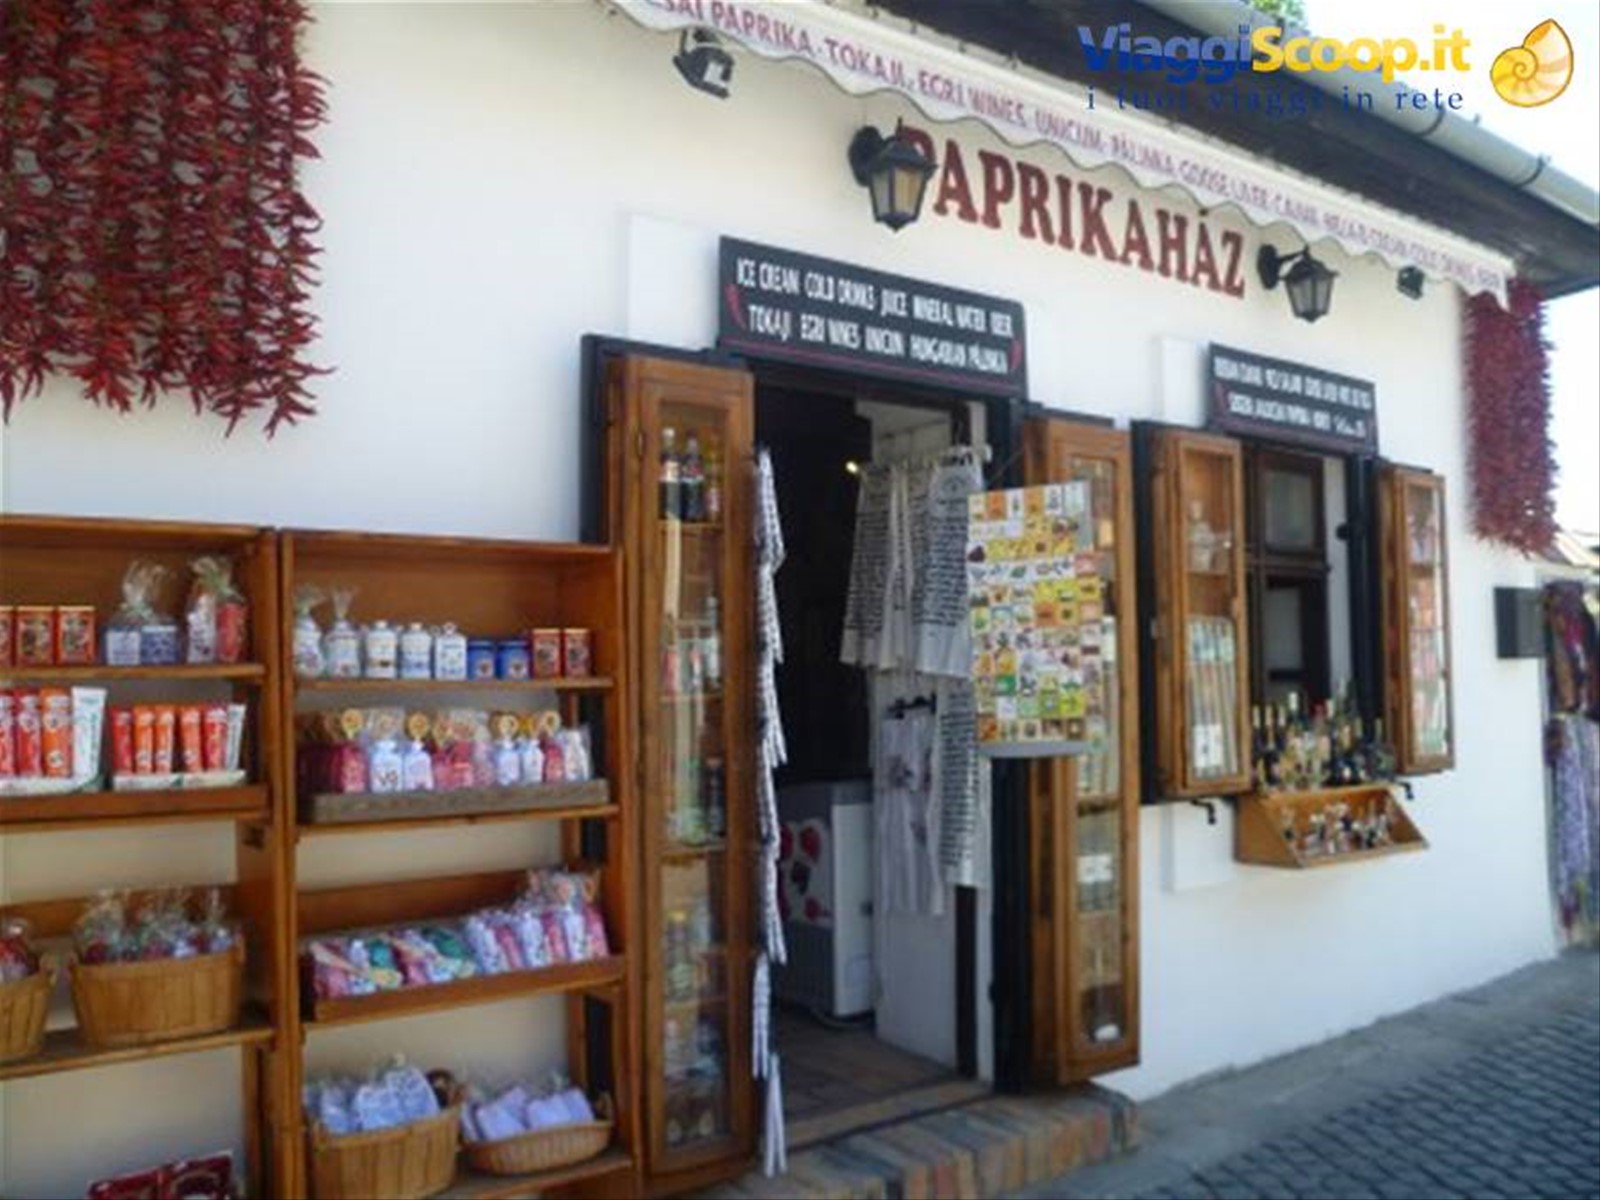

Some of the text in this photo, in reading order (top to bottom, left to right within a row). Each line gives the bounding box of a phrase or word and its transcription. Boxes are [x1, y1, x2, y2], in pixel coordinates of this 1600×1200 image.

[711, 0, 816, 56] PAPRIKA
[737, 257, 756, 288] ICE
[804, 269, 835, 302] COLD
